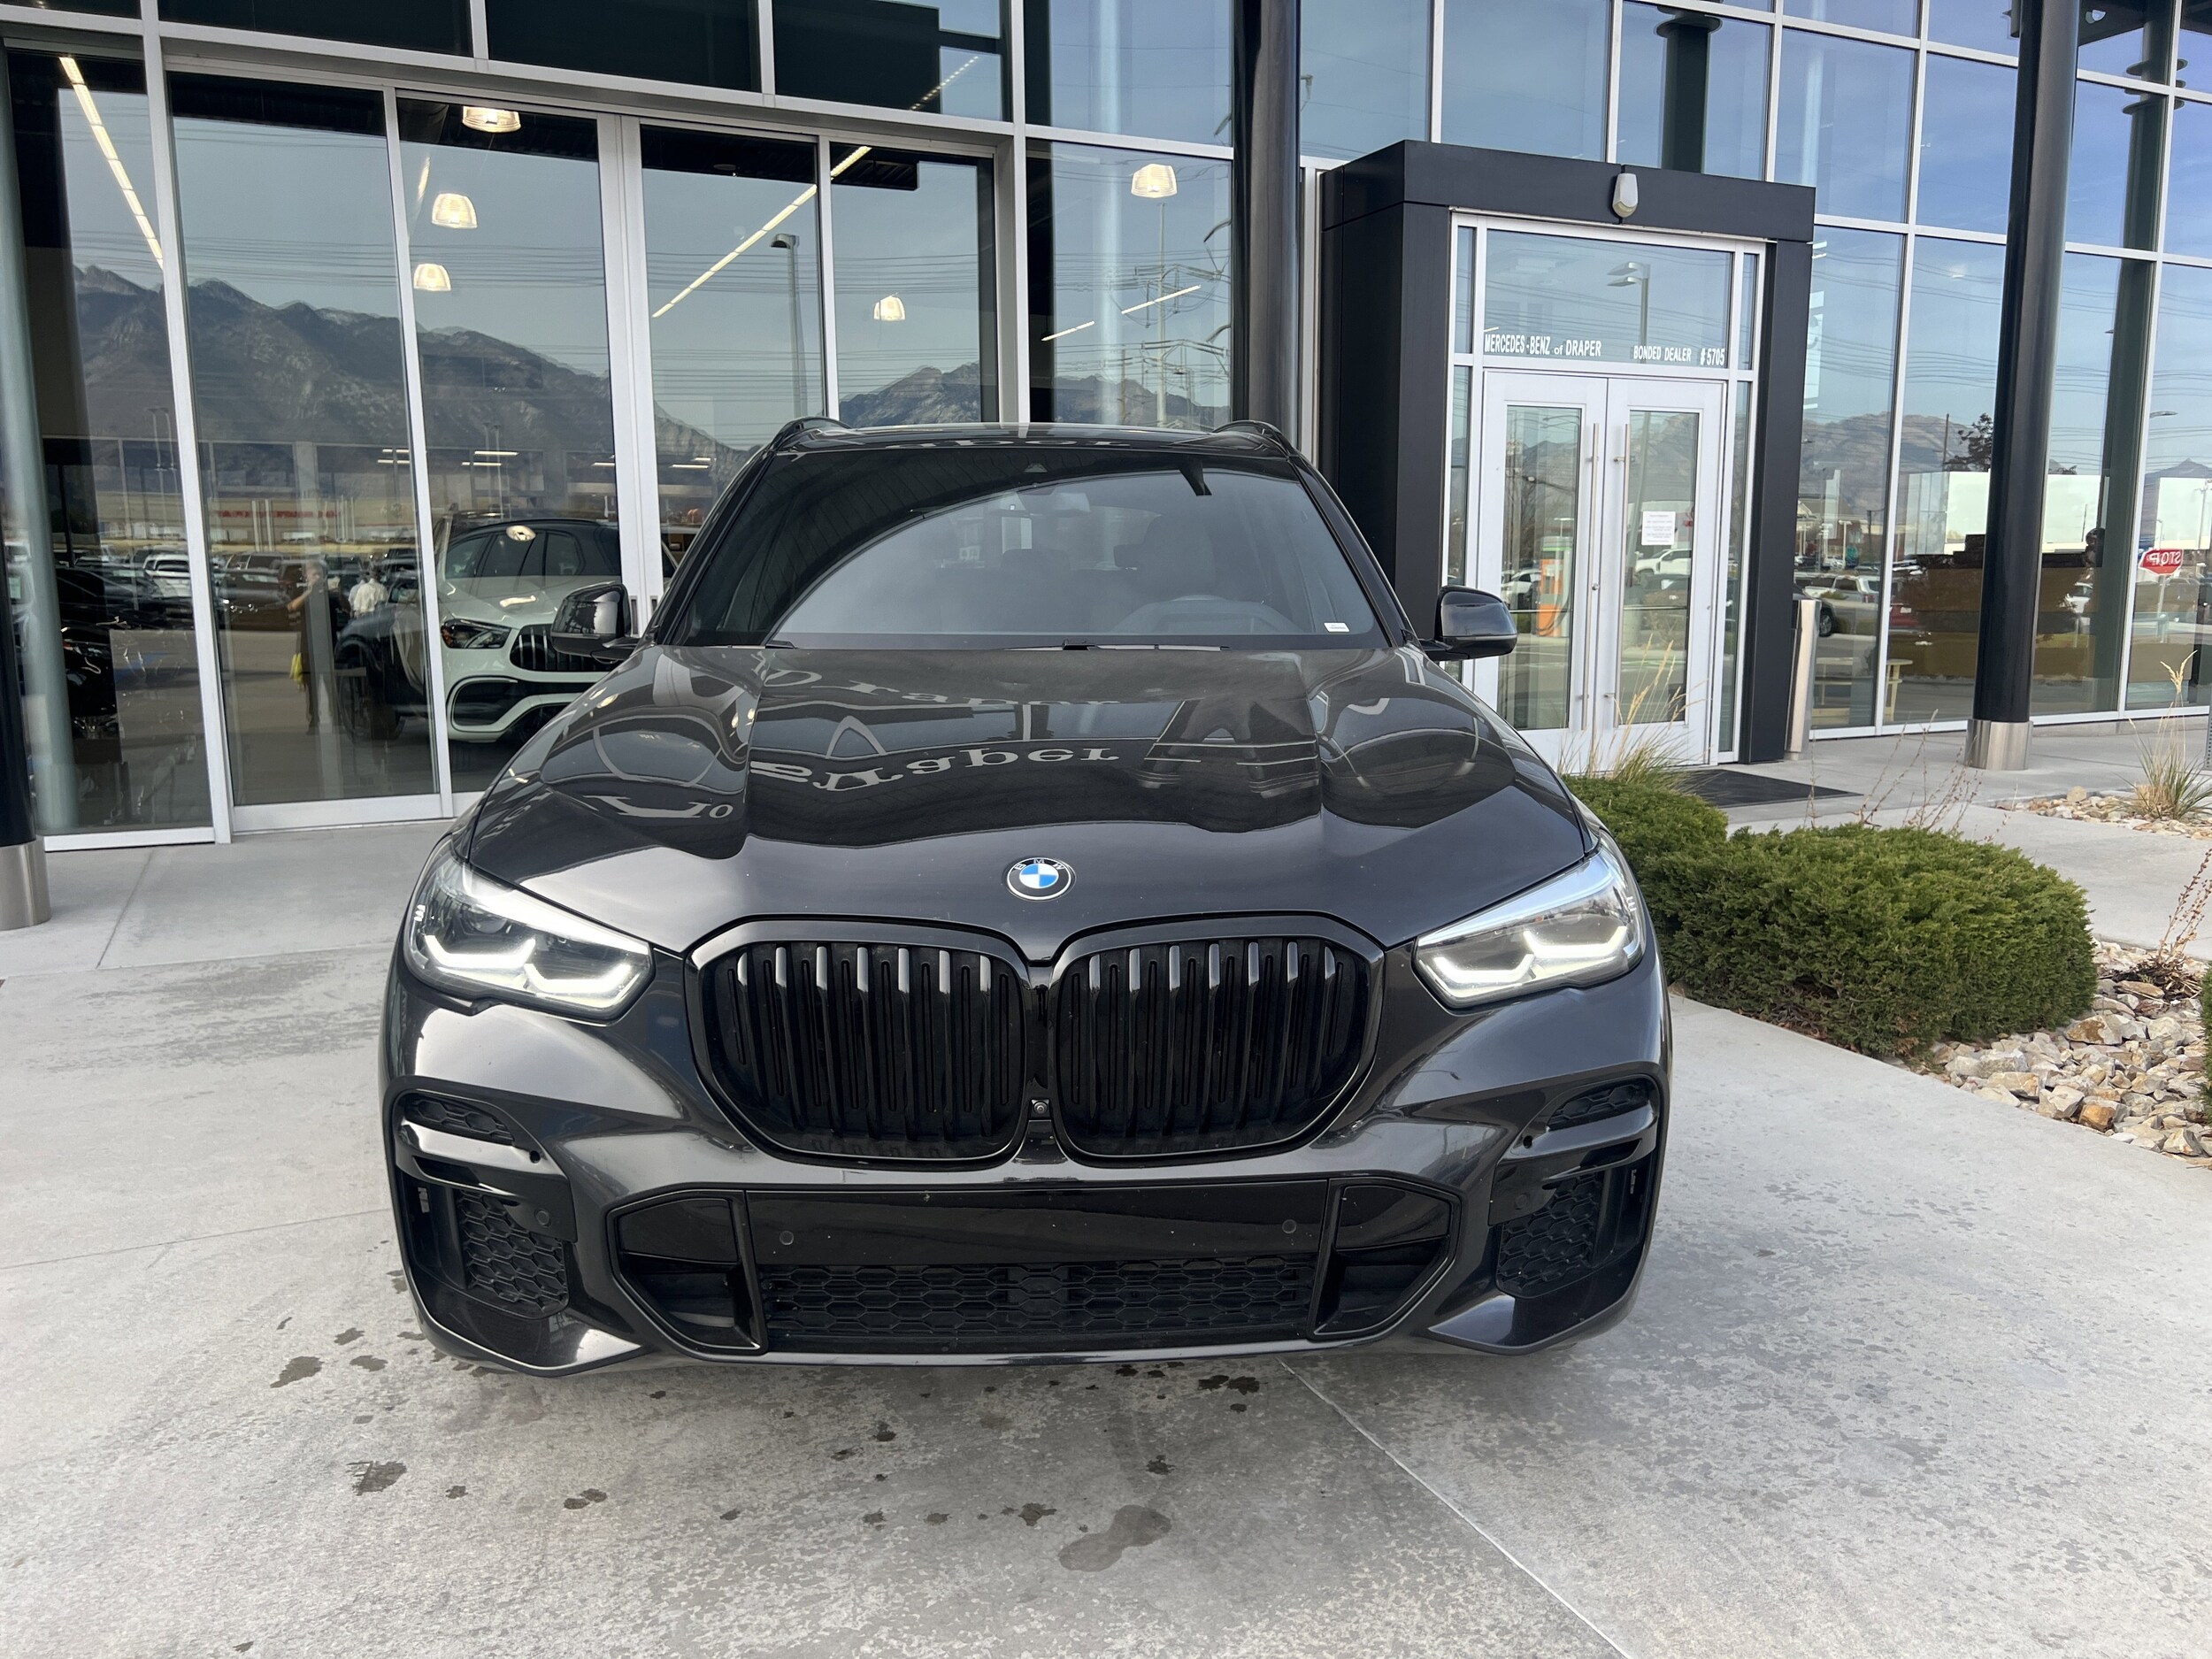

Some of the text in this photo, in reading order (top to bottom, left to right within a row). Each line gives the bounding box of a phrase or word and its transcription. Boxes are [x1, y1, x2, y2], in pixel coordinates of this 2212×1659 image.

[1554, 344, 1563, 355] of
[1565, 339, 1601, 357] DRAPER
[1633, 345, 1662, 360] BONDED
[1664, 347, 1692, 362] DEALER
[1014, 858, 1065, 871] BMW
